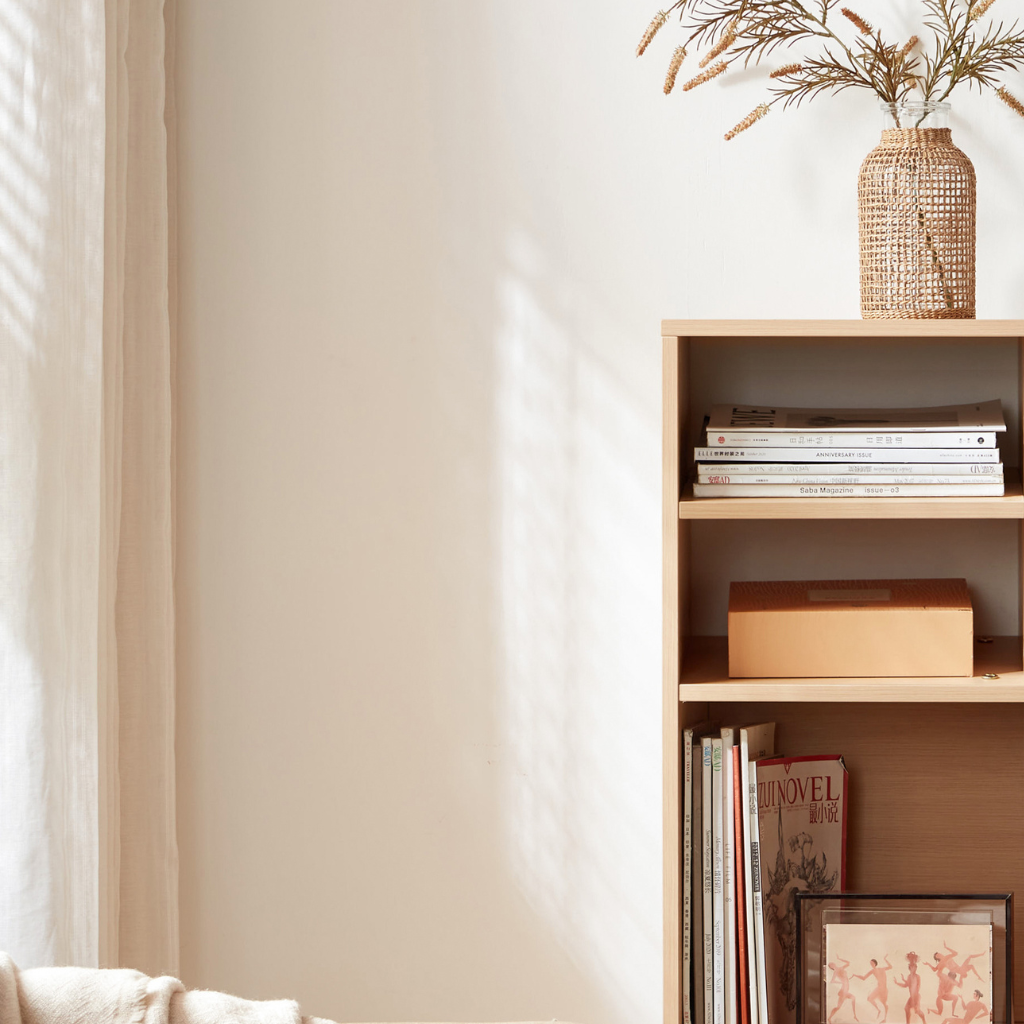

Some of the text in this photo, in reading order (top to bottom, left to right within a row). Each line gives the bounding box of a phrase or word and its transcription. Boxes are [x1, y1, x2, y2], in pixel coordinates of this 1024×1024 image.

[819, 487, 854, 495] Magazine
[758, 776, 840, 808] ZUINOVEL
[809, 801, 839, 824] 最小说
